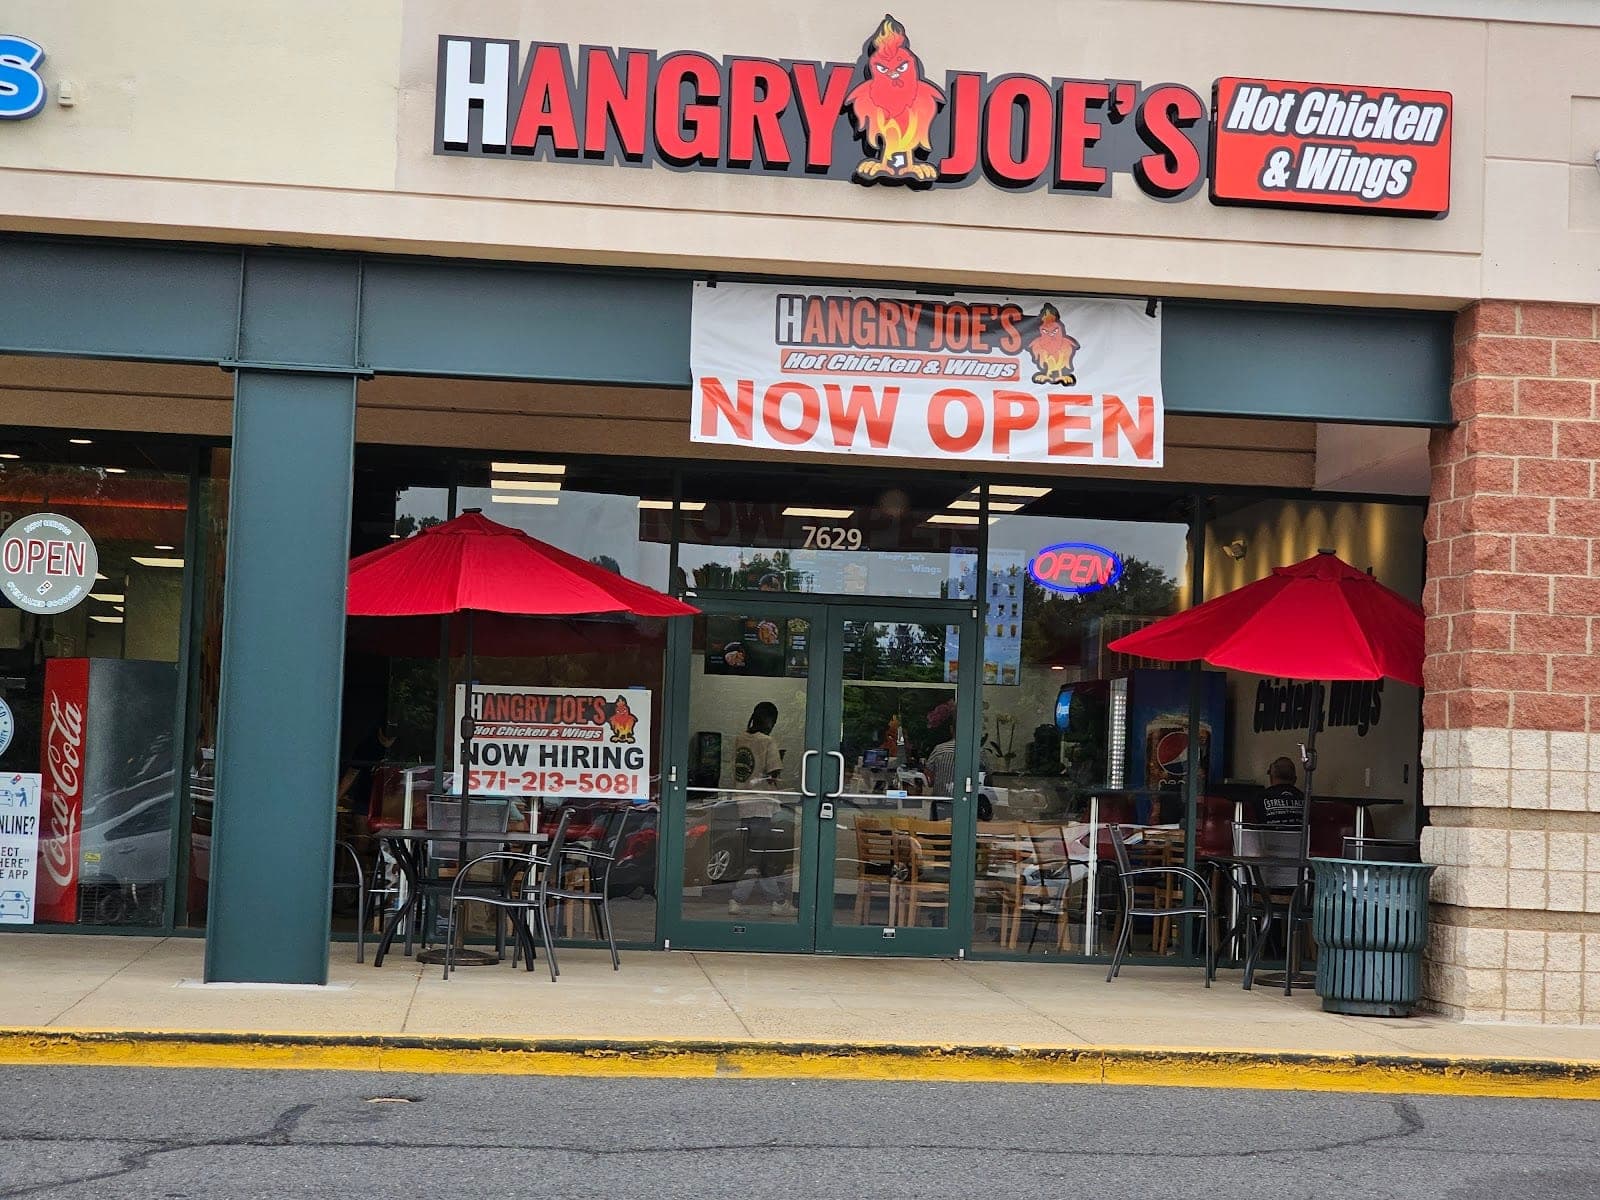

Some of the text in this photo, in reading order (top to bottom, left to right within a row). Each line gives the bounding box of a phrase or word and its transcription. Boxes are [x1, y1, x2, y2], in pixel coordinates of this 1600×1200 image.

[443, 40, 1202, 191] HANGRY JOE'S
[1227, 87, 1444, 142] Hot Chicken
[1262, 147, 1412, 199] & Wings
[779, 297, 1023, 351] HANGRY JOE'S
[783, 352, 1018, 378] Hot Chicken & Wings
[699, 377, 1154, 460] NOW OPEN
[802, 526, 862, 550] 7629
[3, 537, 86, 577] OPEN
[1034, 551, 1114, 585] OPEN
[471, 693, 606, 723] HANGRY JOE'S
[474, 726, 602, 739] Hot Chicken & Wings
[460, 742, 644, 770] NOW HIRING
[43, 689, 83, 887] Coca-Cola
[468, 770, 638, 795] 571-213-5081
[8, 869, 29, 880] APP
